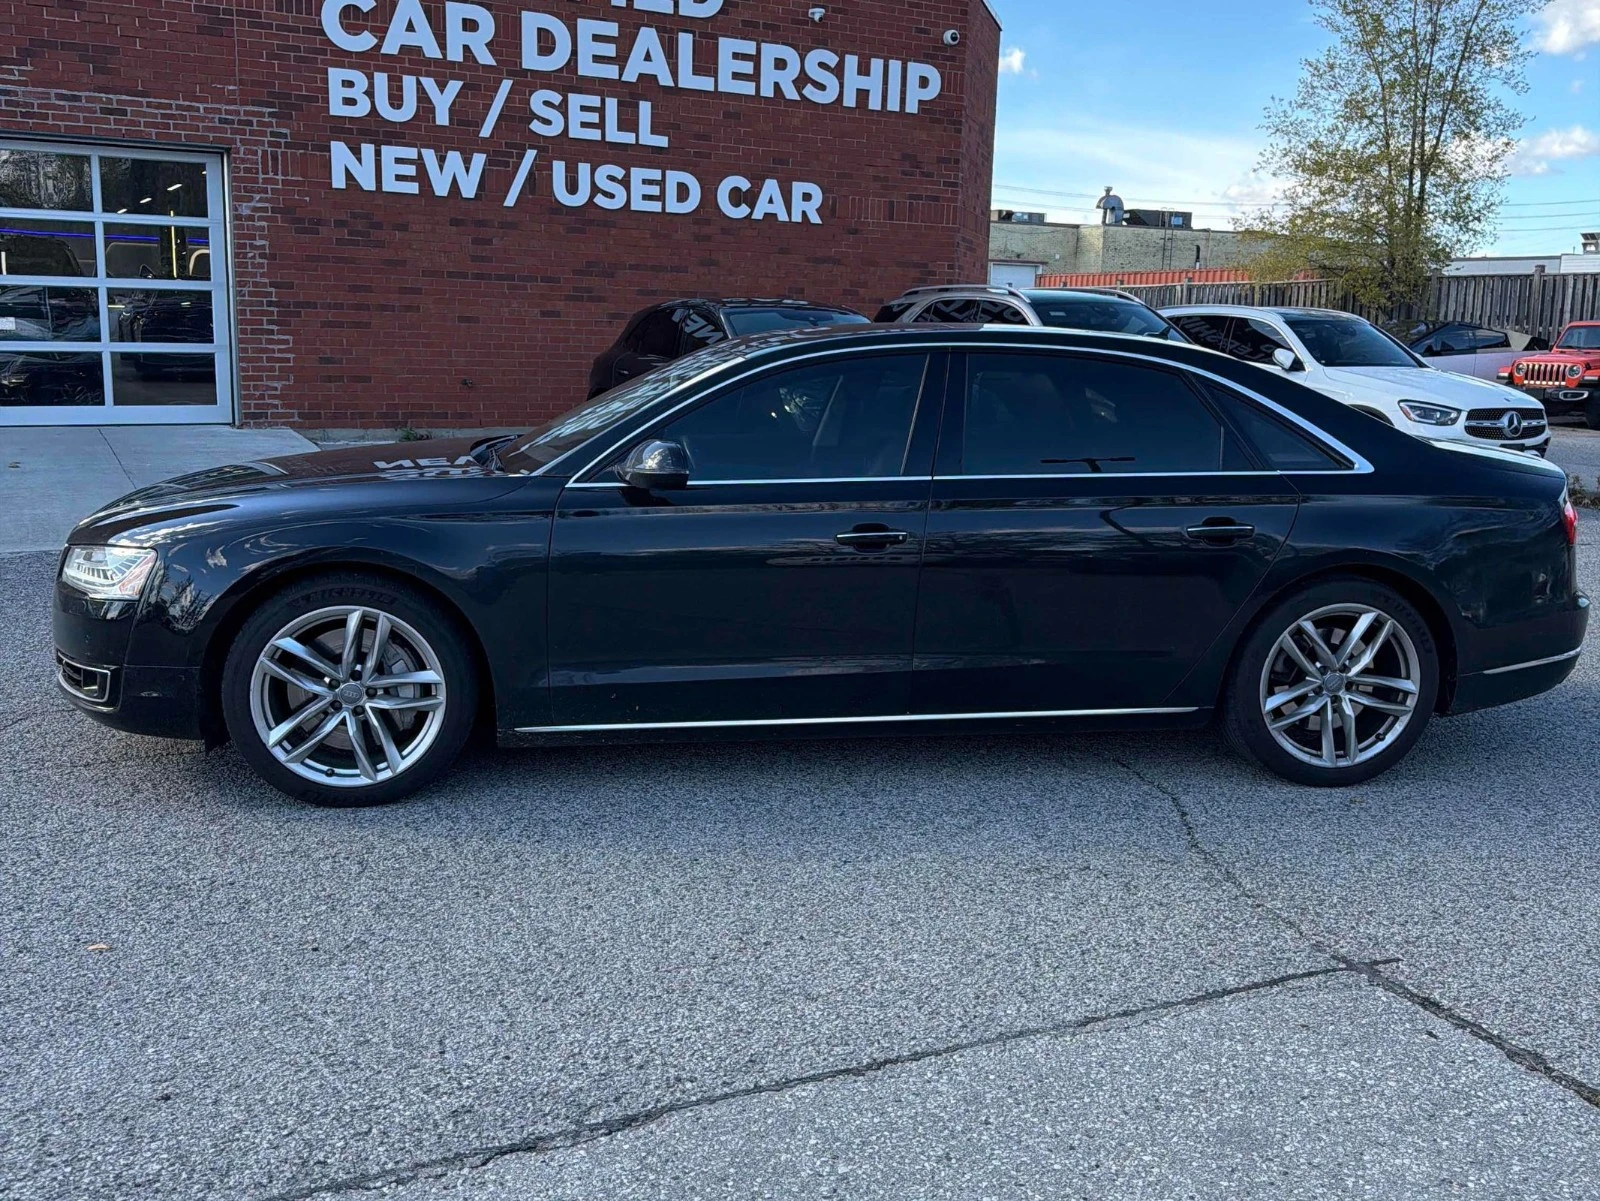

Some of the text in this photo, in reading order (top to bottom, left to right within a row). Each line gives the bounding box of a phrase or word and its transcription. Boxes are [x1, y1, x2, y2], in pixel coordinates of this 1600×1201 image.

[320, 0, 942, 114] CAR DEALERSHIP
[327, 67, 669, 148] BUY / SELL
[330, 140, 823, 225] NEW / USED CAR
